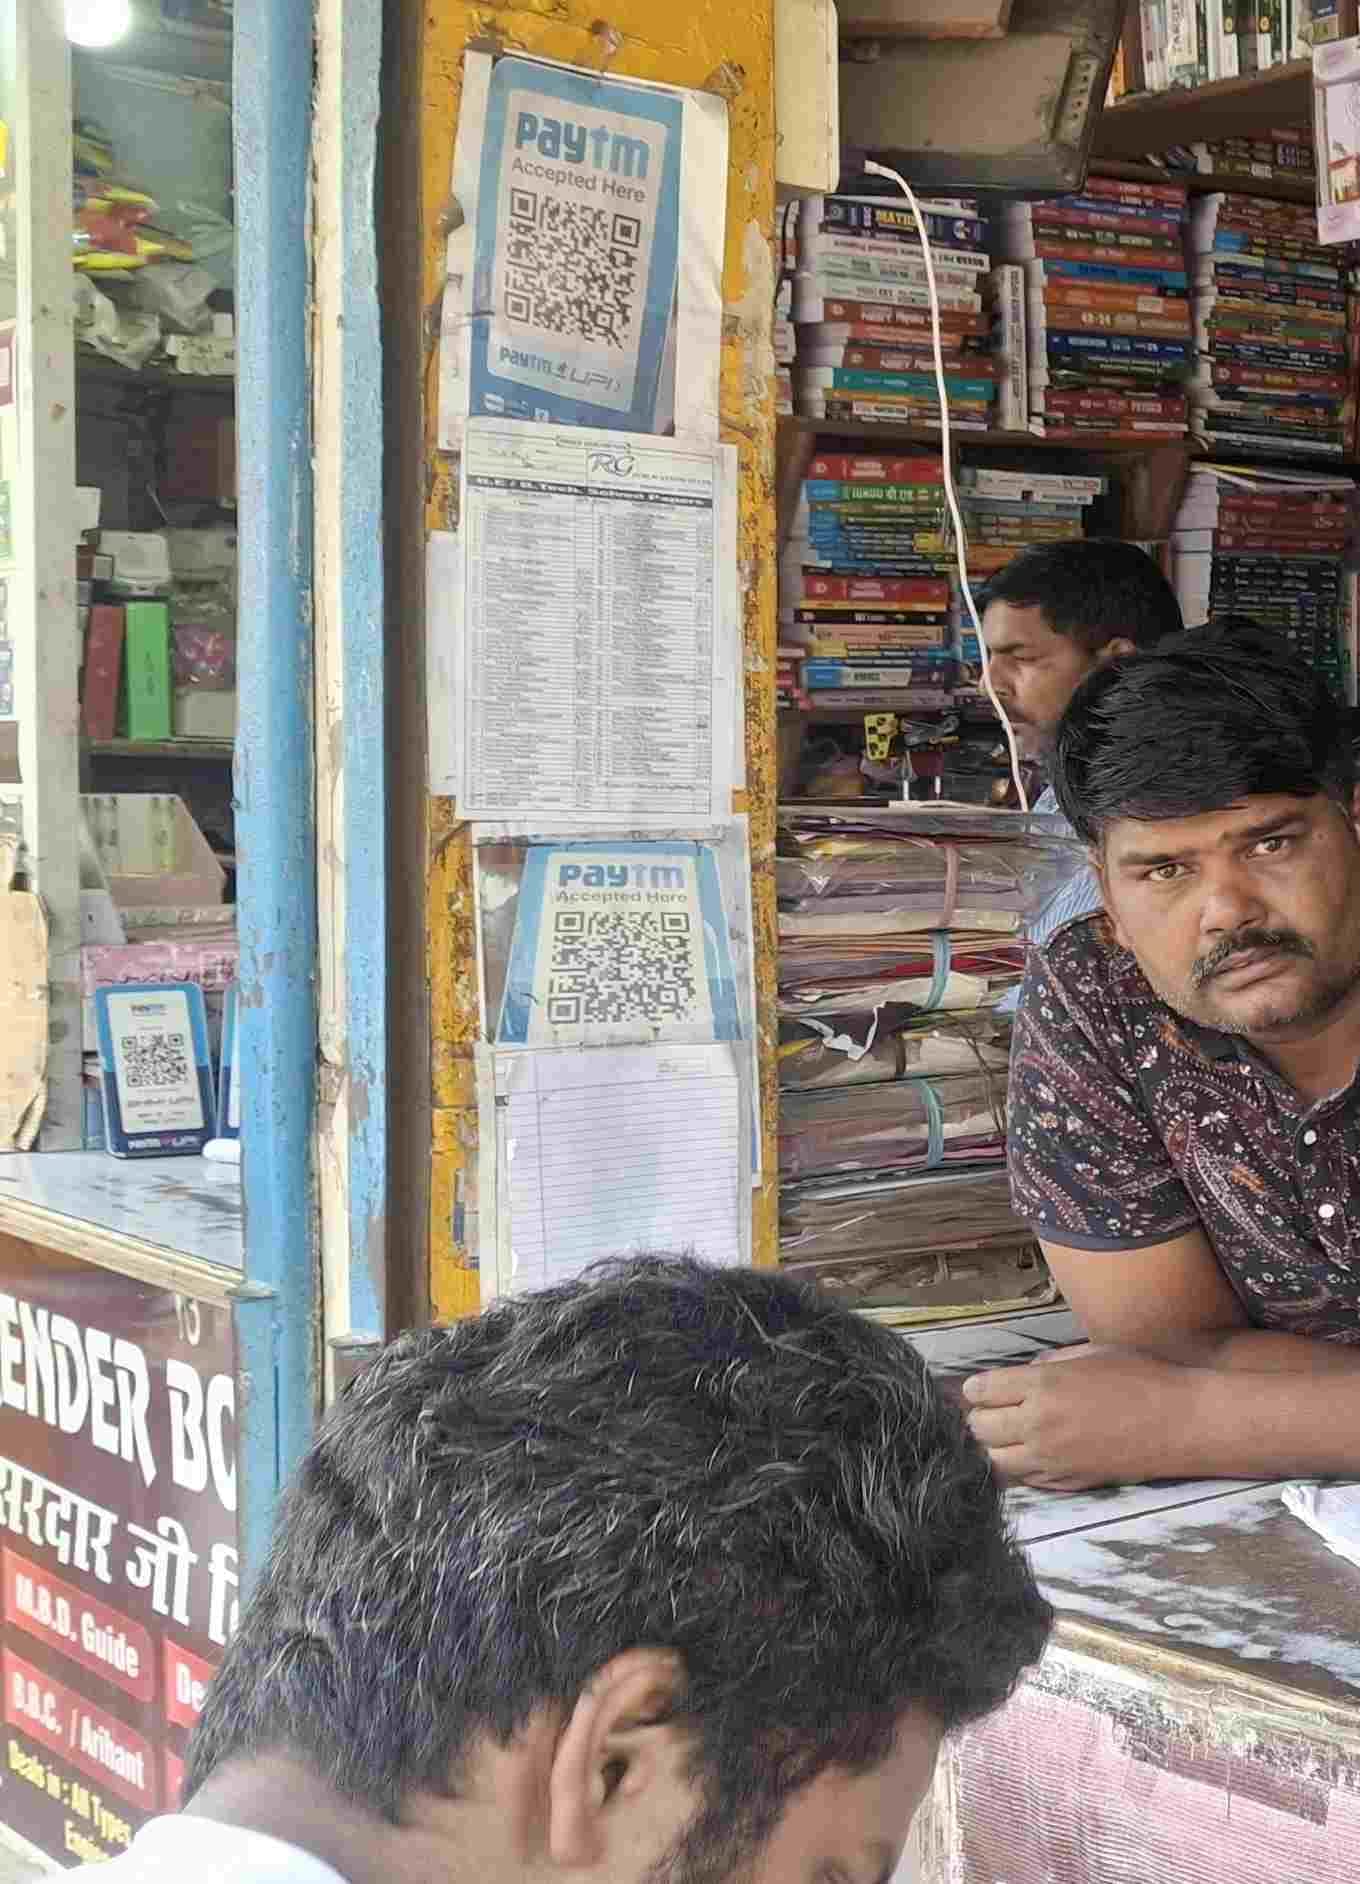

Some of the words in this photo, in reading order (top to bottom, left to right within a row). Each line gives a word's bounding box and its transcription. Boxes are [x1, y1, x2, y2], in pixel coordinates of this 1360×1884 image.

[512, 156, 597, 191] Accepted
[601, 178, 646, 202] Here
[556, 891, 641, 904] Accepted
[647, 891, 686, 902] Here
[125, 1516, 198, 1627] जी
[81, 1612, 139, 1678] Guide
[81, 1715, 145, 1790] Arihant
